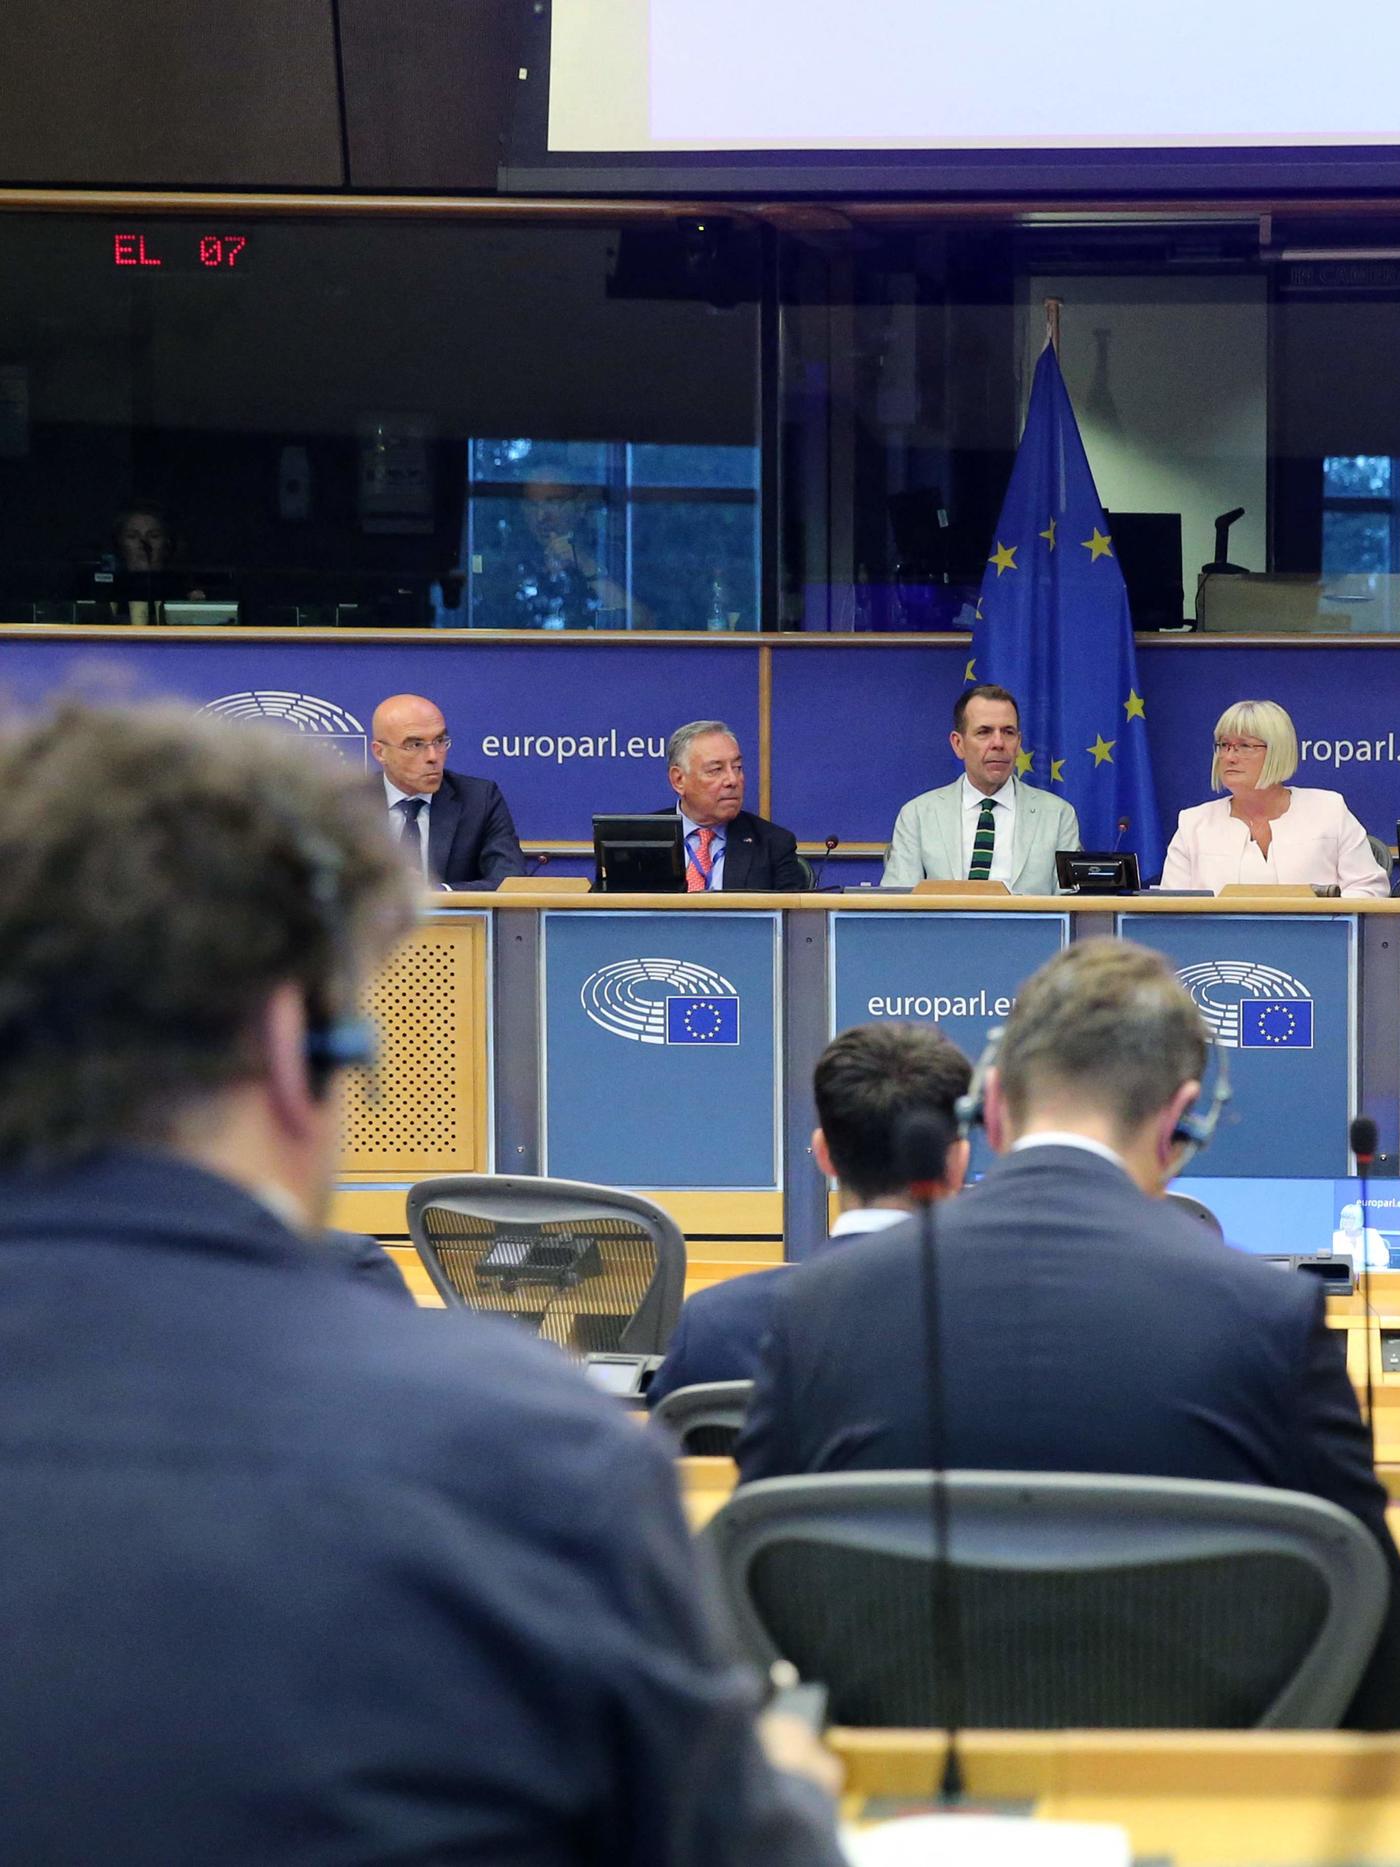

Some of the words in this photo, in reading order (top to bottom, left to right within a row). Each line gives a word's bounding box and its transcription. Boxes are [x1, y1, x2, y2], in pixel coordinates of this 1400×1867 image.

[115, 234, 161, 265] EL
[200, 236, 247, 266] 07
[481, 728, 666, 764] europarl.eu
[868, 990, 1016, 1022] europarl.e
